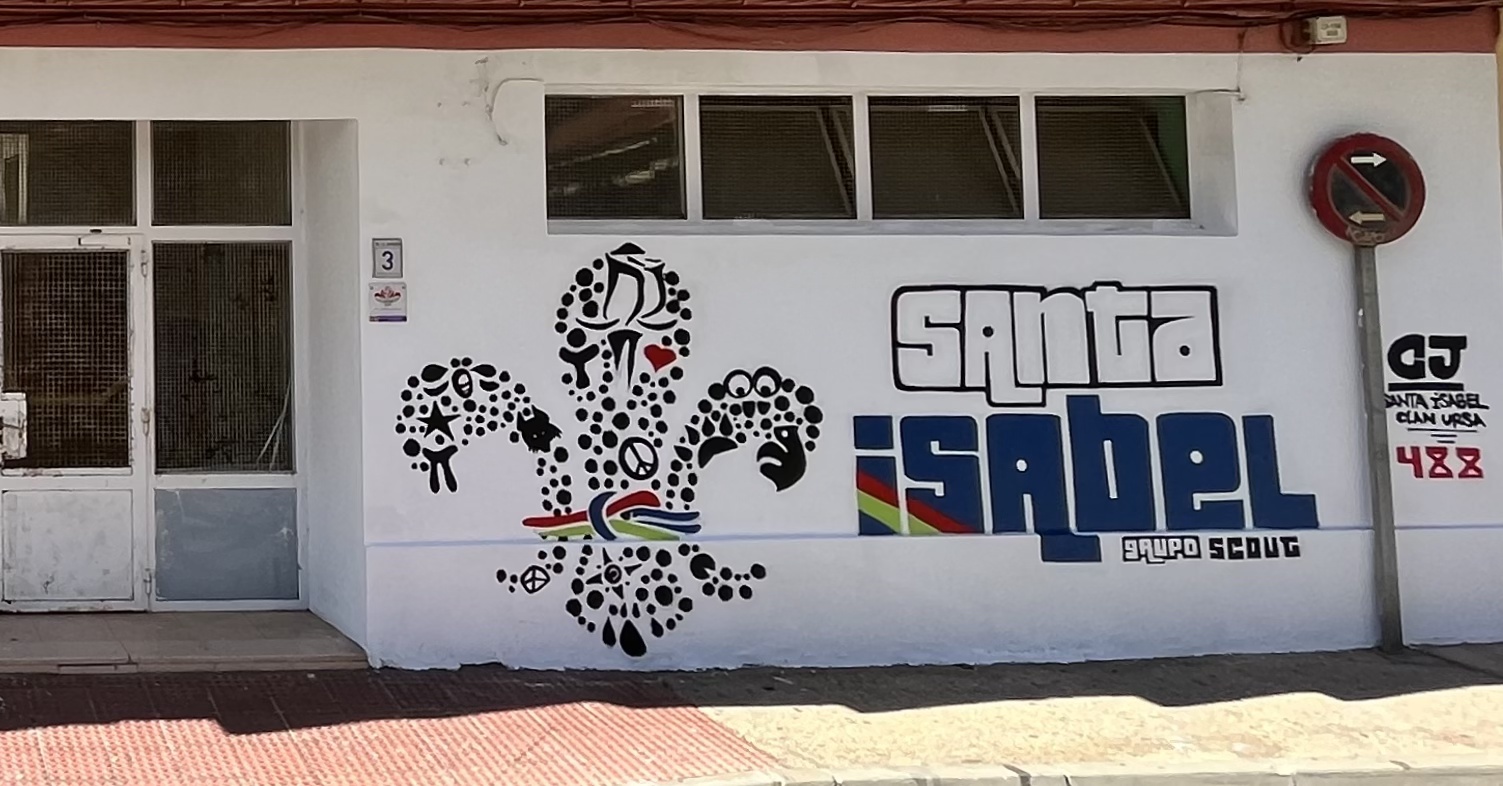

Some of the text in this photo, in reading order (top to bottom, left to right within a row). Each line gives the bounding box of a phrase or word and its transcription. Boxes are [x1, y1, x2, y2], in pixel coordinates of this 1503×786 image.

[381, 250, 394, 271] 3
[1387, 334, 1468, 380] CJ
[1396, 446, 1484, 479] 488
[1209, 536, 1301, 560] SCOUT
